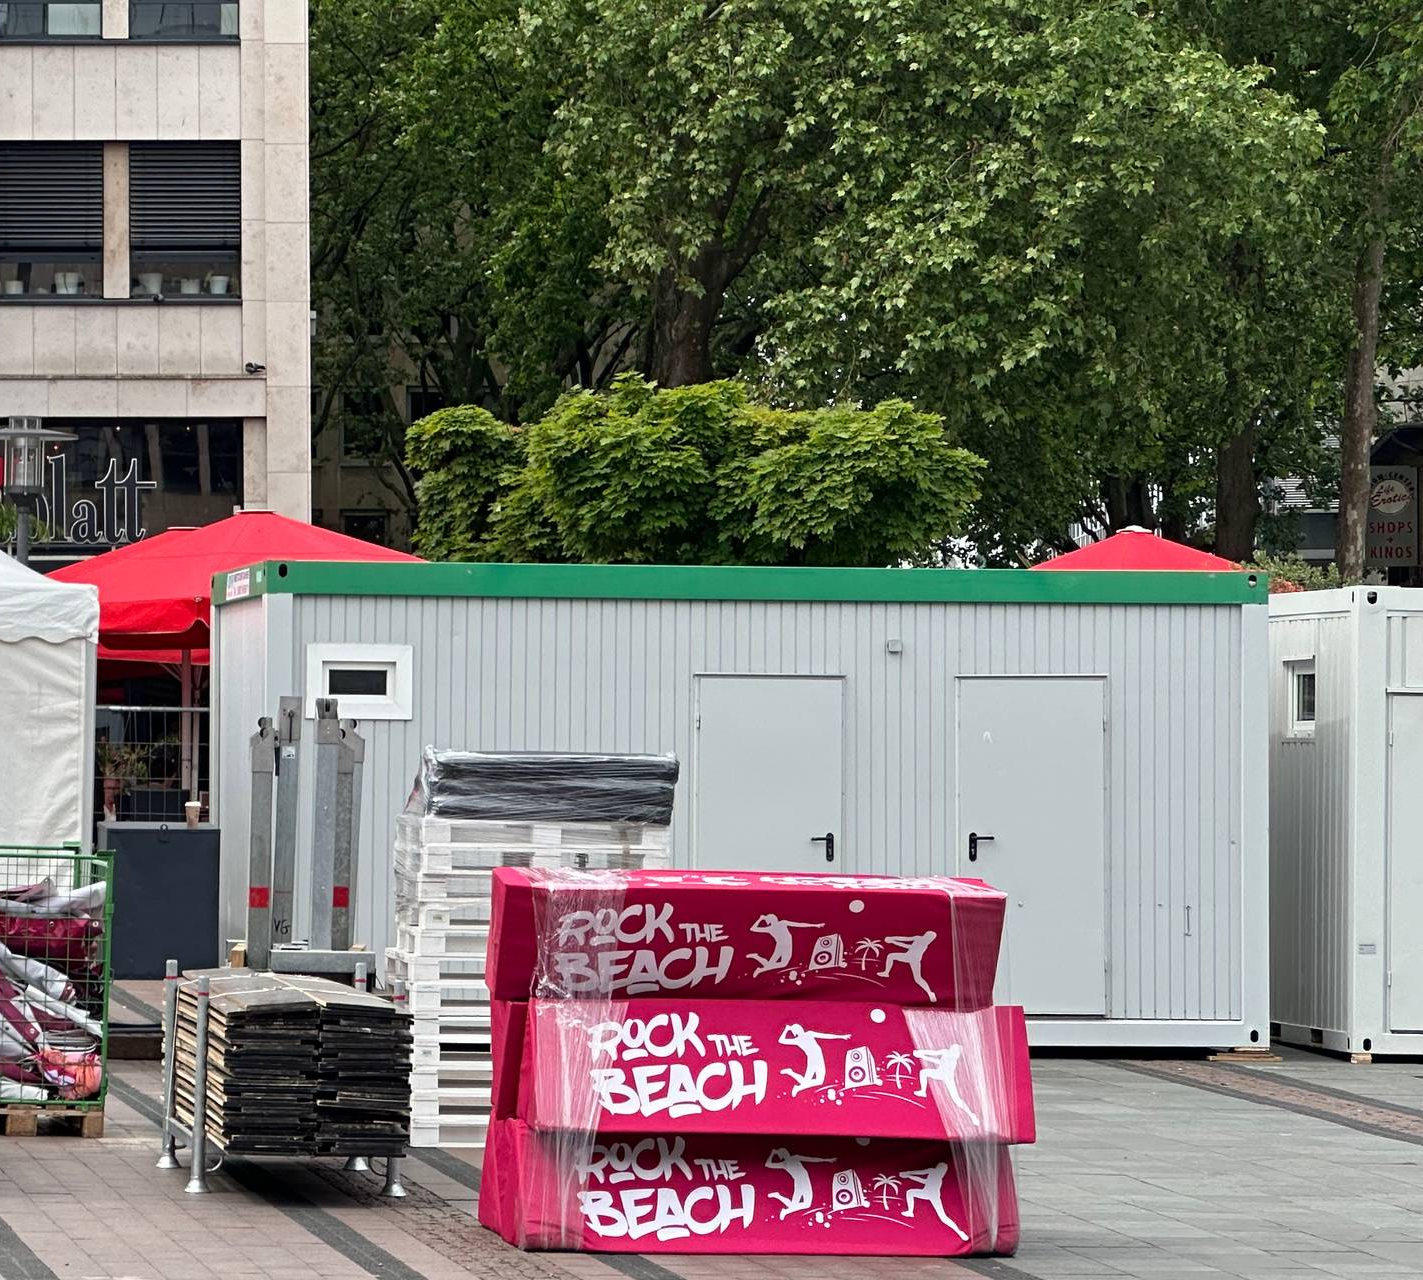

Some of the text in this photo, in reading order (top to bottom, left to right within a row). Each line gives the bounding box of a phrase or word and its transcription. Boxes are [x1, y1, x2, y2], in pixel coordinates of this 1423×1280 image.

[1369, 521, 1413, 534] SHOPS
[1370, 545, 1413, 559] KINOS
[557, 902, 730, 947] ROCK THE
[554, 945, 735, 996] BEACH
[587, 1011, 761, 1064] ROCK THE
[589, 1059, 769, 1119] BEACH
[576, 1135, 747, 1185] ROCK THE
[576, 1183, 756, 1242] BEACH
